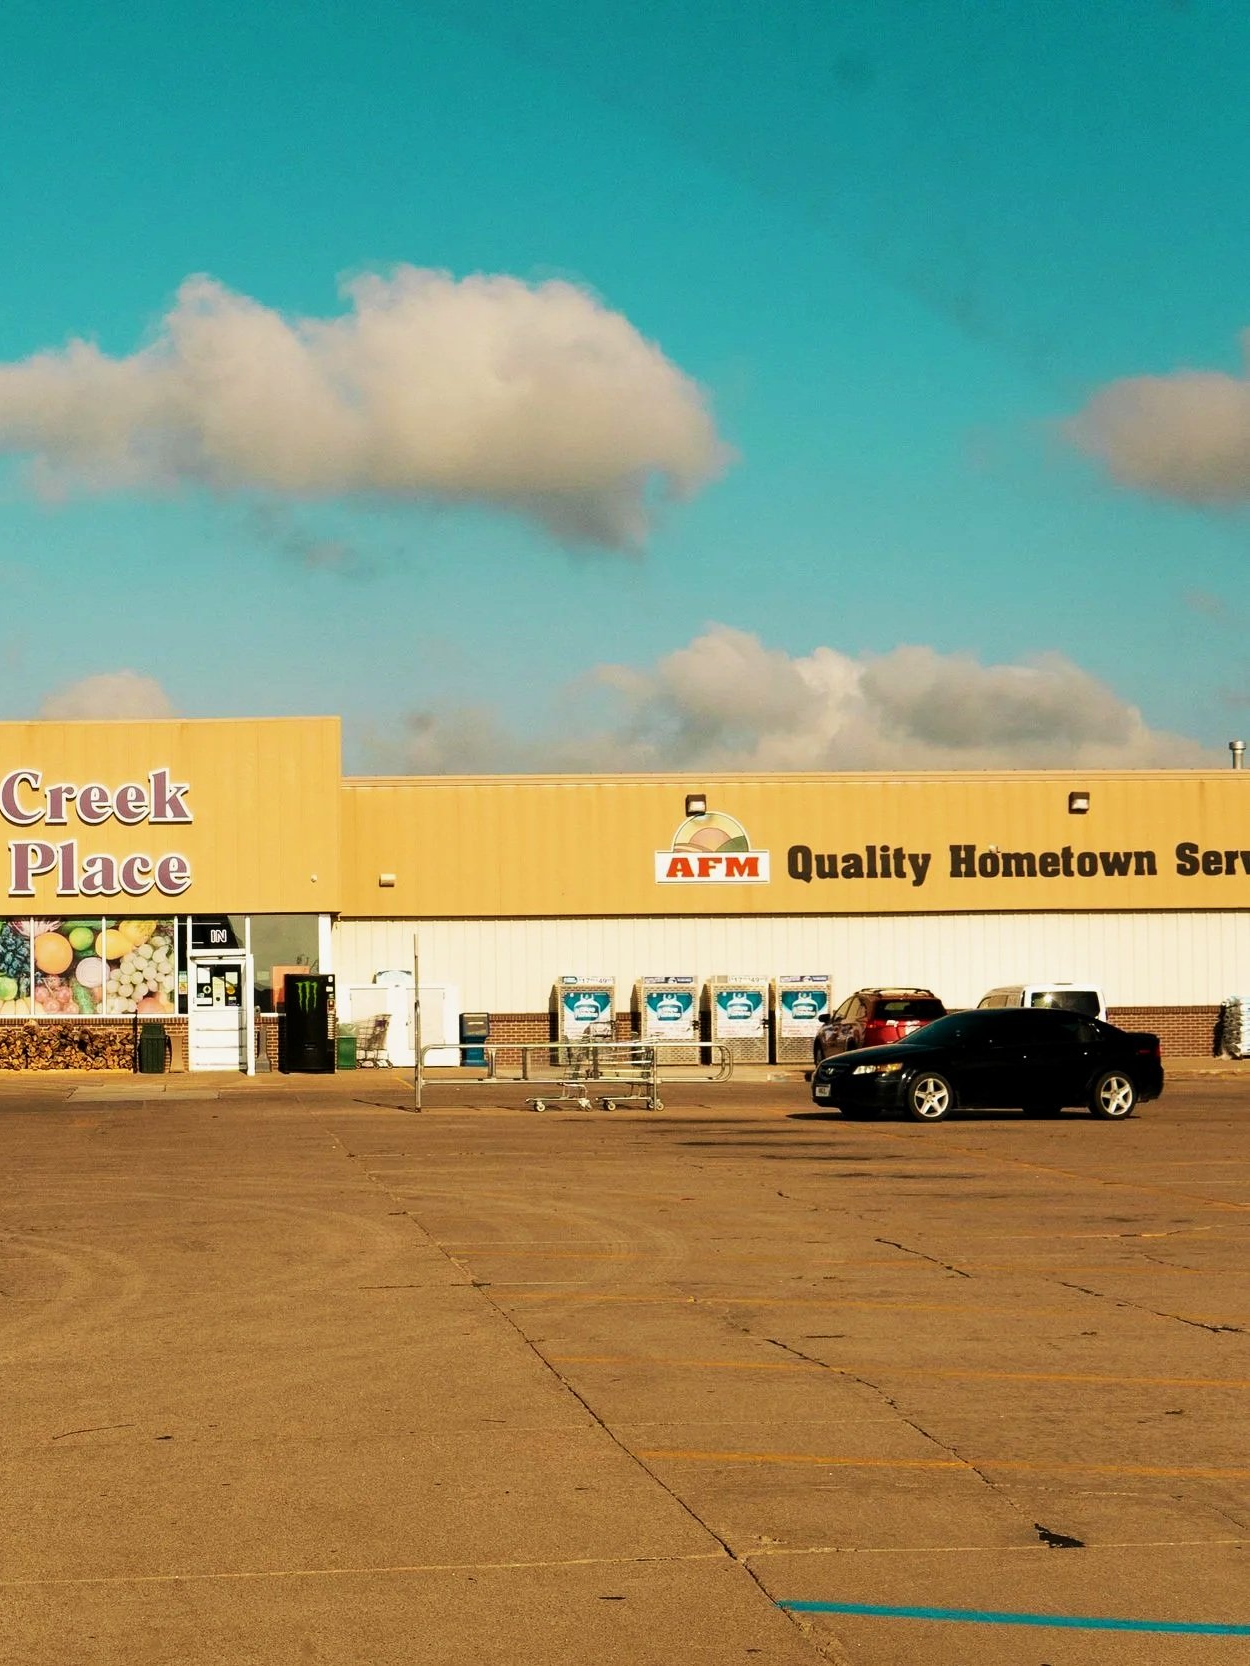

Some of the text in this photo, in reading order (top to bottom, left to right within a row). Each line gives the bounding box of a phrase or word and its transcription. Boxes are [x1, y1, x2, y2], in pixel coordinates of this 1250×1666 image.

[8, 839, 191, 898] Place
[665, 856, 760, 878] AFM
[787, 844, 932, 887] Quality
[949, 844, 1158, 878] Hometown
[210, 929, 227, 943] IN
